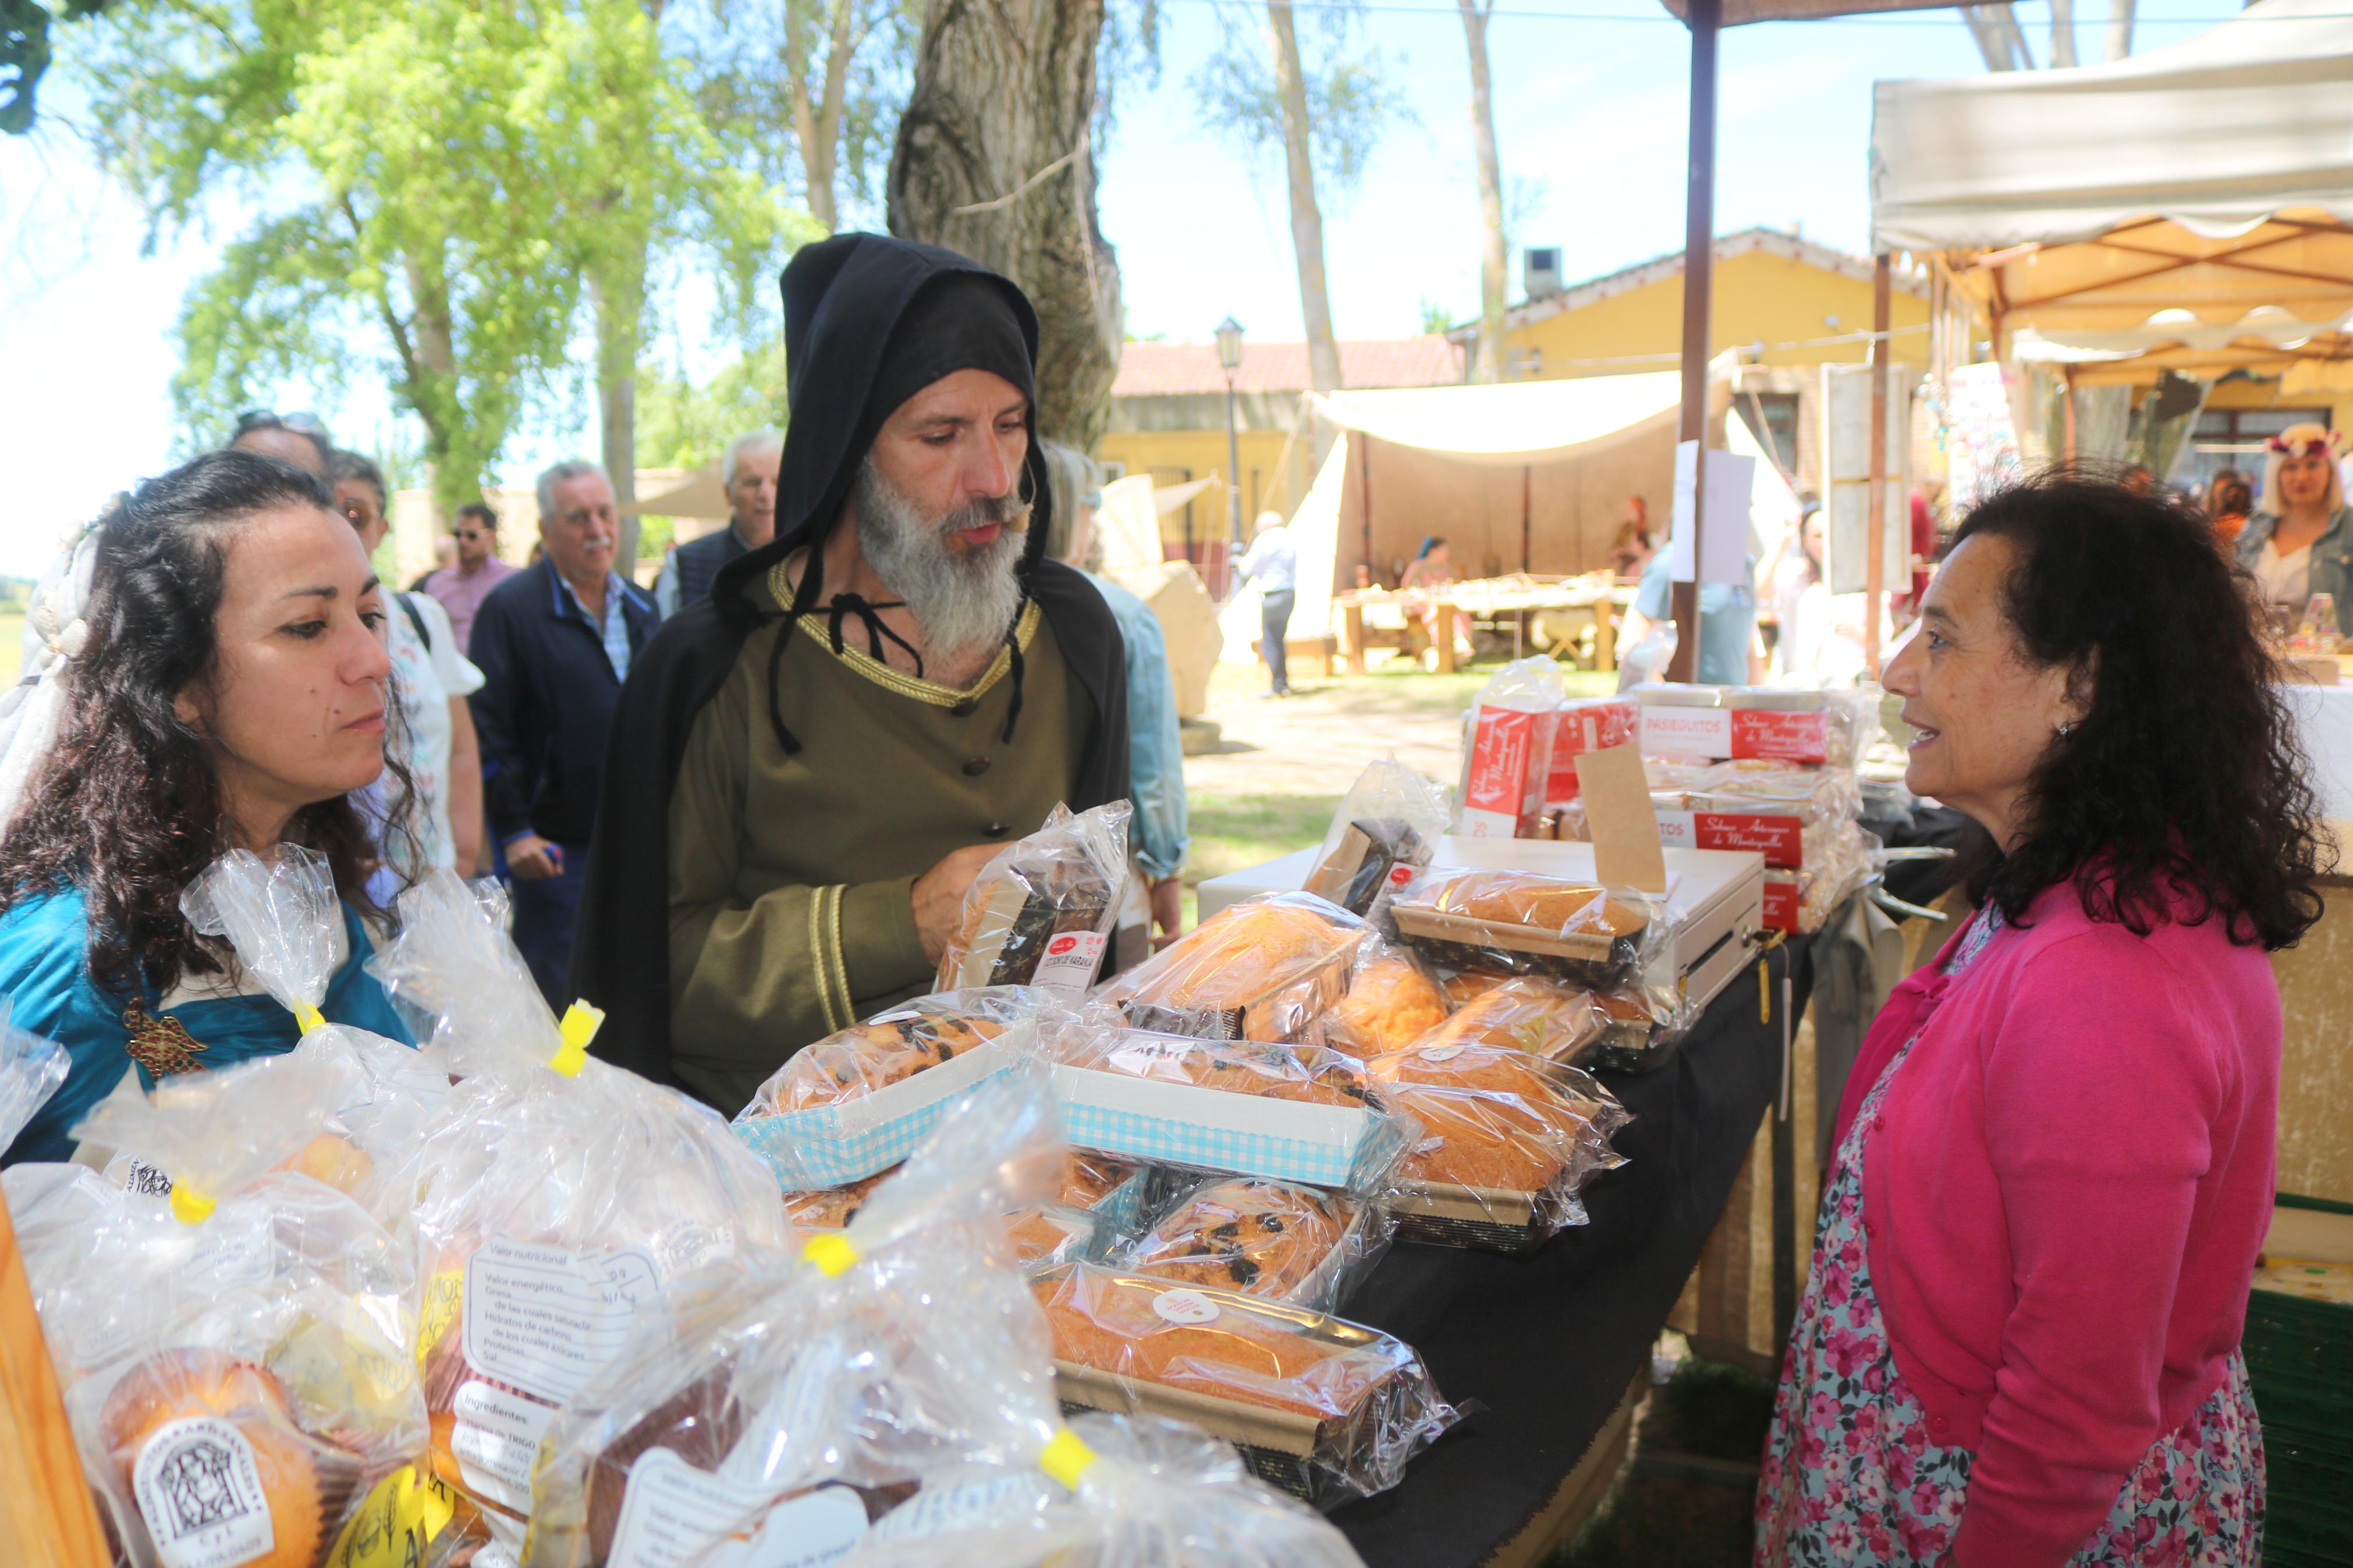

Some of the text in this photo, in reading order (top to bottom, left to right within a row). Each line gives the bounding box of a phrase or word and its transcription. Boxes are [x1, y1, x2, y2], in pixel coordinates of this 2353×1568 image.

[1646, 717, 1721, 733] PASIEGUITOS
[489, 1243, 567, 1265] Valor nutricional
[485, 1272, 563, 1293] Valor energético
[485, 1286, 512, 1298] Grasa
[495, 1301, 506, 1310] de
[508, 1303, 521, 1314] las
[523, 1309, 552, 1321] cuales
[484, 1311, 572, 1342] Hidratos de carbono
[493, 1328, 505, 1338] de
[506, 1331, 520, 1342] los
[521, 1334, 549, 1349] cuales
[483, 1350, 498, 1361] Sal
[465, 1393, 530, 1425] Ingredientes:
[508, 1433, 535, 1450] TRIGO
